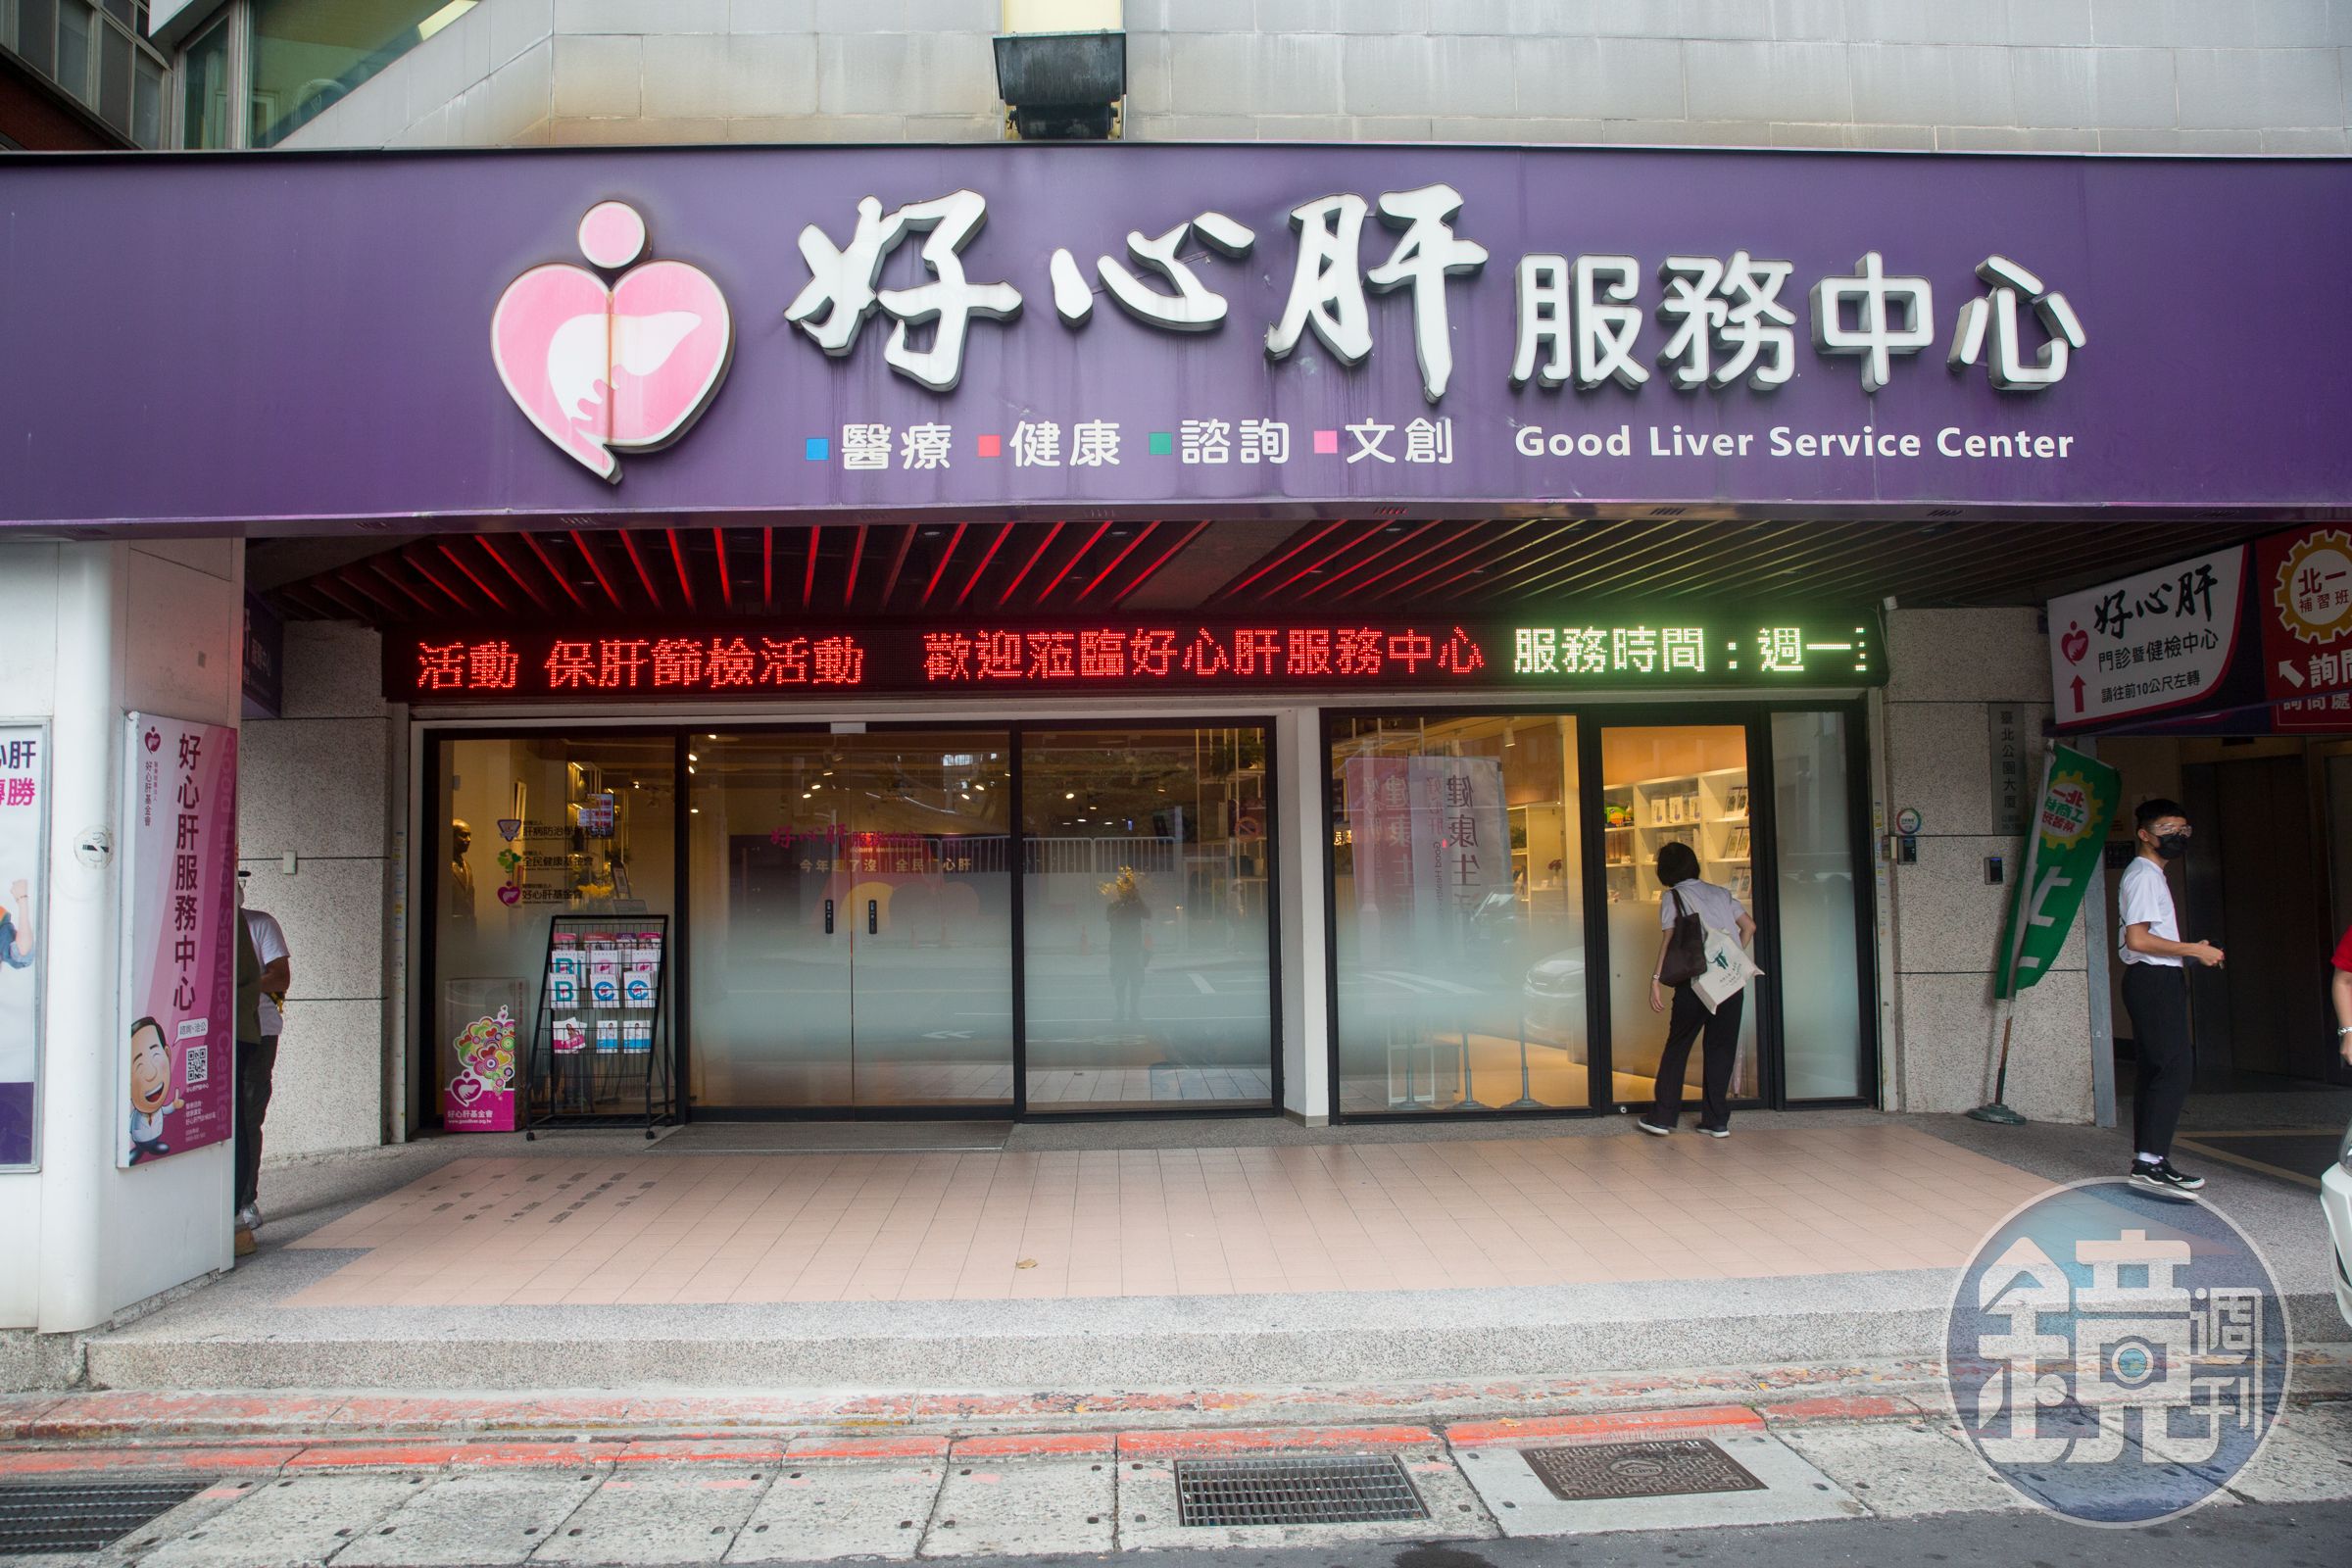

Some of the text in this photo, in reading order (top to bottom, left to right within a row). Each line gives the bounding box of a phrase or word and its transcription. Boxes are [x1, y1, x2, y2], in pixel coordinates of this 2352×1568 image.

[785, 188, 2087, 404] 好心肝 服務中心
[841, 417, 1453, 471] 醫療 健康 諮詢 文創
[1515, 425, 2075, 459] Good Liver Service Center
[2094, 564, 2219, 640] 好心肝
[2298, 566, 2347, 597] 北一
[2298, 589, 2350, 613] 補習班
[416, 626, 1486, 689] 活動 保肝篩檢活動 歡迎蒞臨好心肝服務中心
[2098, 628, 2219, 673] 門診暨健檢中心
[2101, 669, 2201, 704] 請往前10公尺左轉
[0, 740, 36, 769] 肝
[172, 733, 202, 1012] 好心肝服務中心
[896, 858, 972, 872] 全民心肝
[215, 732, 237, 1136] Good Liver Service Center
